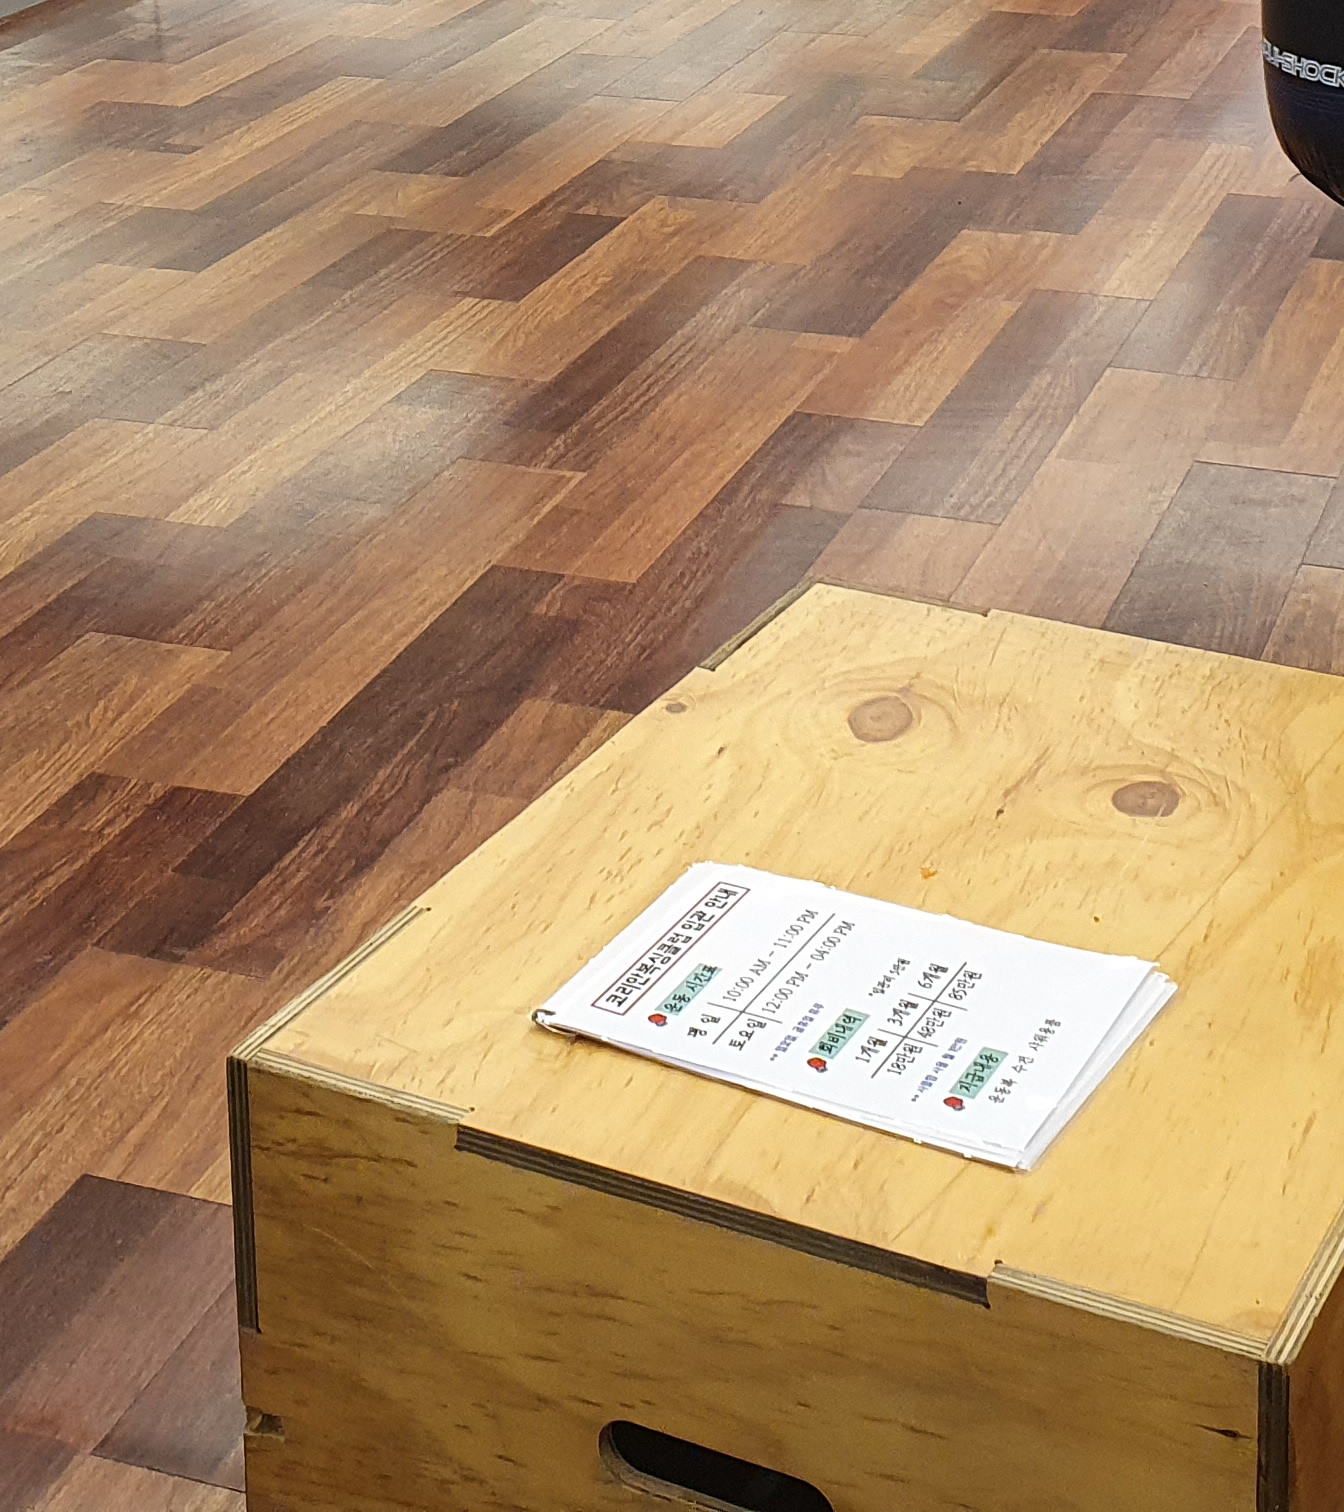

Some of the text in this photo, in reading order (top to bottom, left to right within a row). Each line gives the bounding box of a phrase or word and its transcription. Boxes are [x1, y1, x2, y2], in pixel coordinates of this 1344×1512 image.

[606, 888, 738, 1007] 코리안복싱클럽 입관 안내
[664, 965, 717, 1012] 운동 시간표
[688, 1027, 707, 1037] 평
[701, 1014, 720, 1023] 일
[723, 977, 754, 1001] 10:00
[749, 959, 770, 976] AM
[774, 925, 803, 948] 11:00
[797, 909, 818, 924] PM
[729, 1019, 766, 1051] 토요일
[762, 988, 793, 1013] 12:00
[786, 971, 808, 987] PM
[810, 937, 840, 960] 04:00
[834, 921, 855, 936] PM
[819, 1014, 861, 1054] 회비내역
[856, 964, 948, 1063] 1개월 3개월 6개월
[887, 971, 982, 1075] 18만원 48만원 85만원
[959, 1054, 998, 1092] 지급내용
[989, 1079, 1016, 1103] 운동복
[1012, 1056, 1034, 1073] 수건
